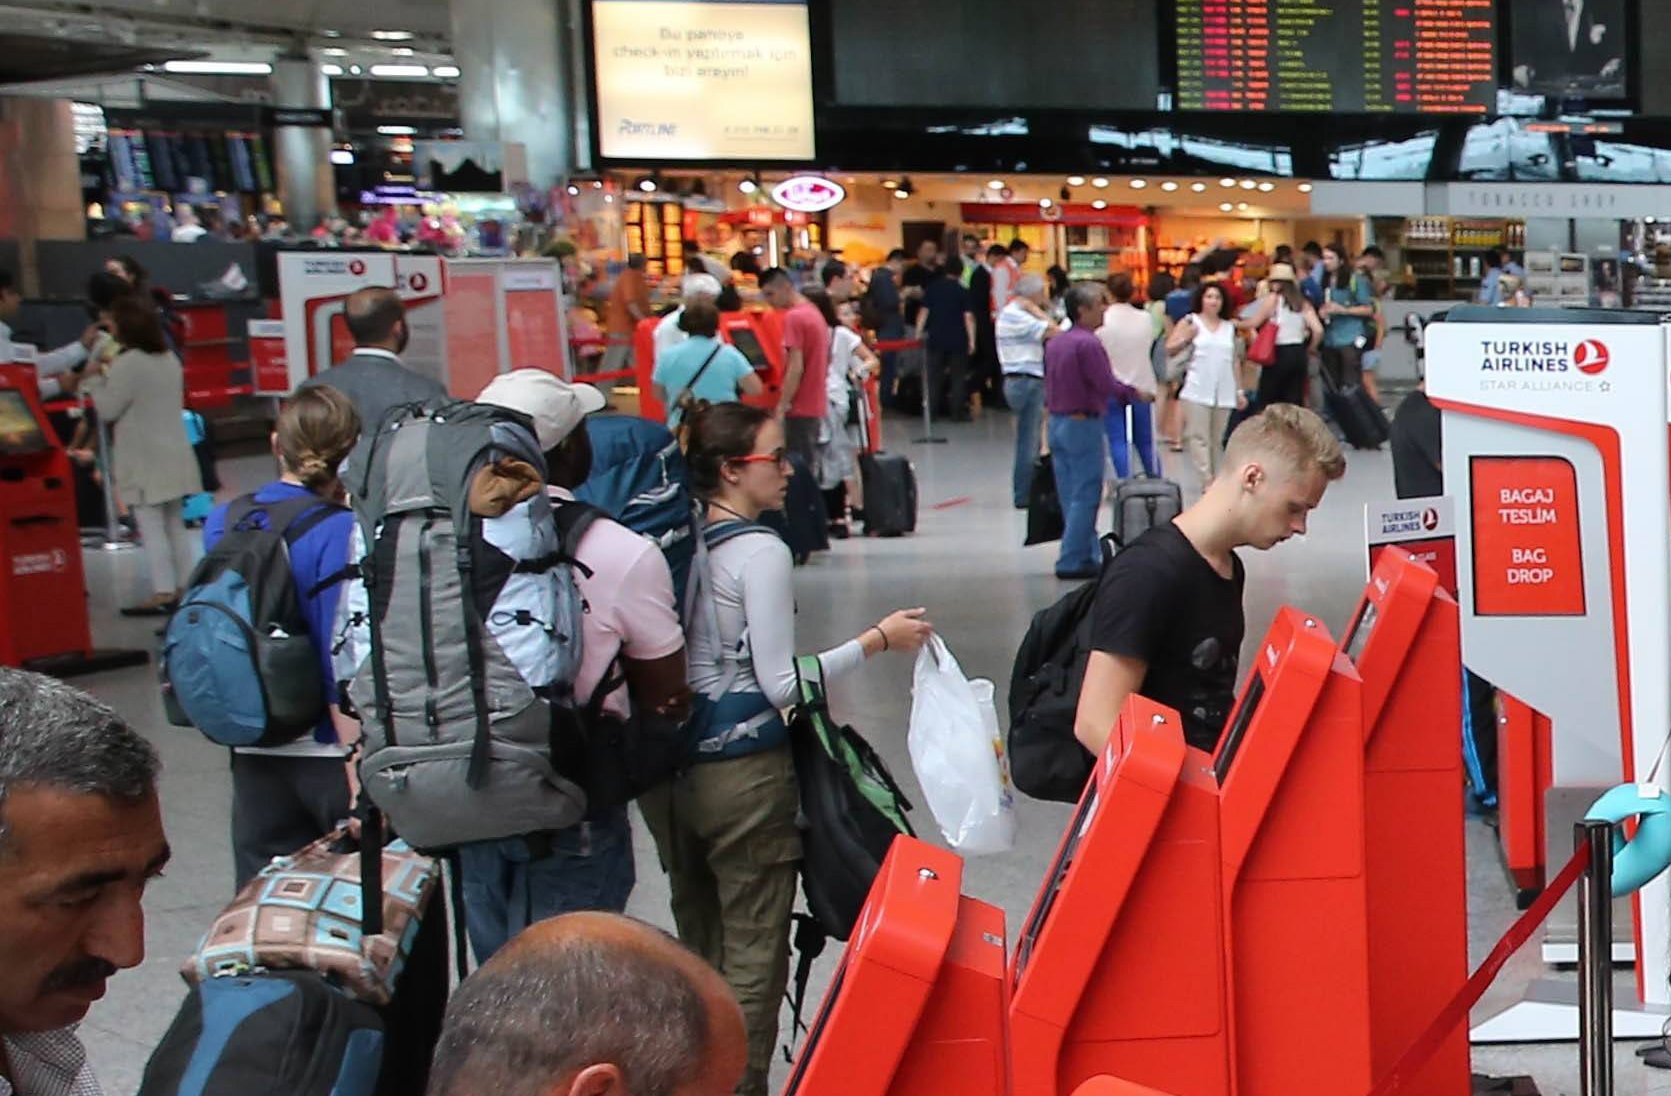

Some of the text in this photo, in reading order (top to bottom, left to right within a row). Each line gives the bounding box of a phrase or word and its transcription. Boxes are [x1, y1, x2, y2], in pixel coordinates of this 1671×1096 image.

[1469, 190, 1554, 208] TOBACCO
[1481, 340, 1568, 356] TURKISH
[1481, 358, 1568, 372] AIRLINES
[1480, 380, 1592, 392] STAR ALLIANCE
[1500, 488, 1553, 505] BAGAJ
[1381, 511, 1420, 523] TURKISH
[1499, 506, 1556, 524] TESLİM
[1382, 522, 1420, 534] AIRLINES
[1512, 548, 1547, 564] BAG
[1507, 566, 1553, 584] DROP
